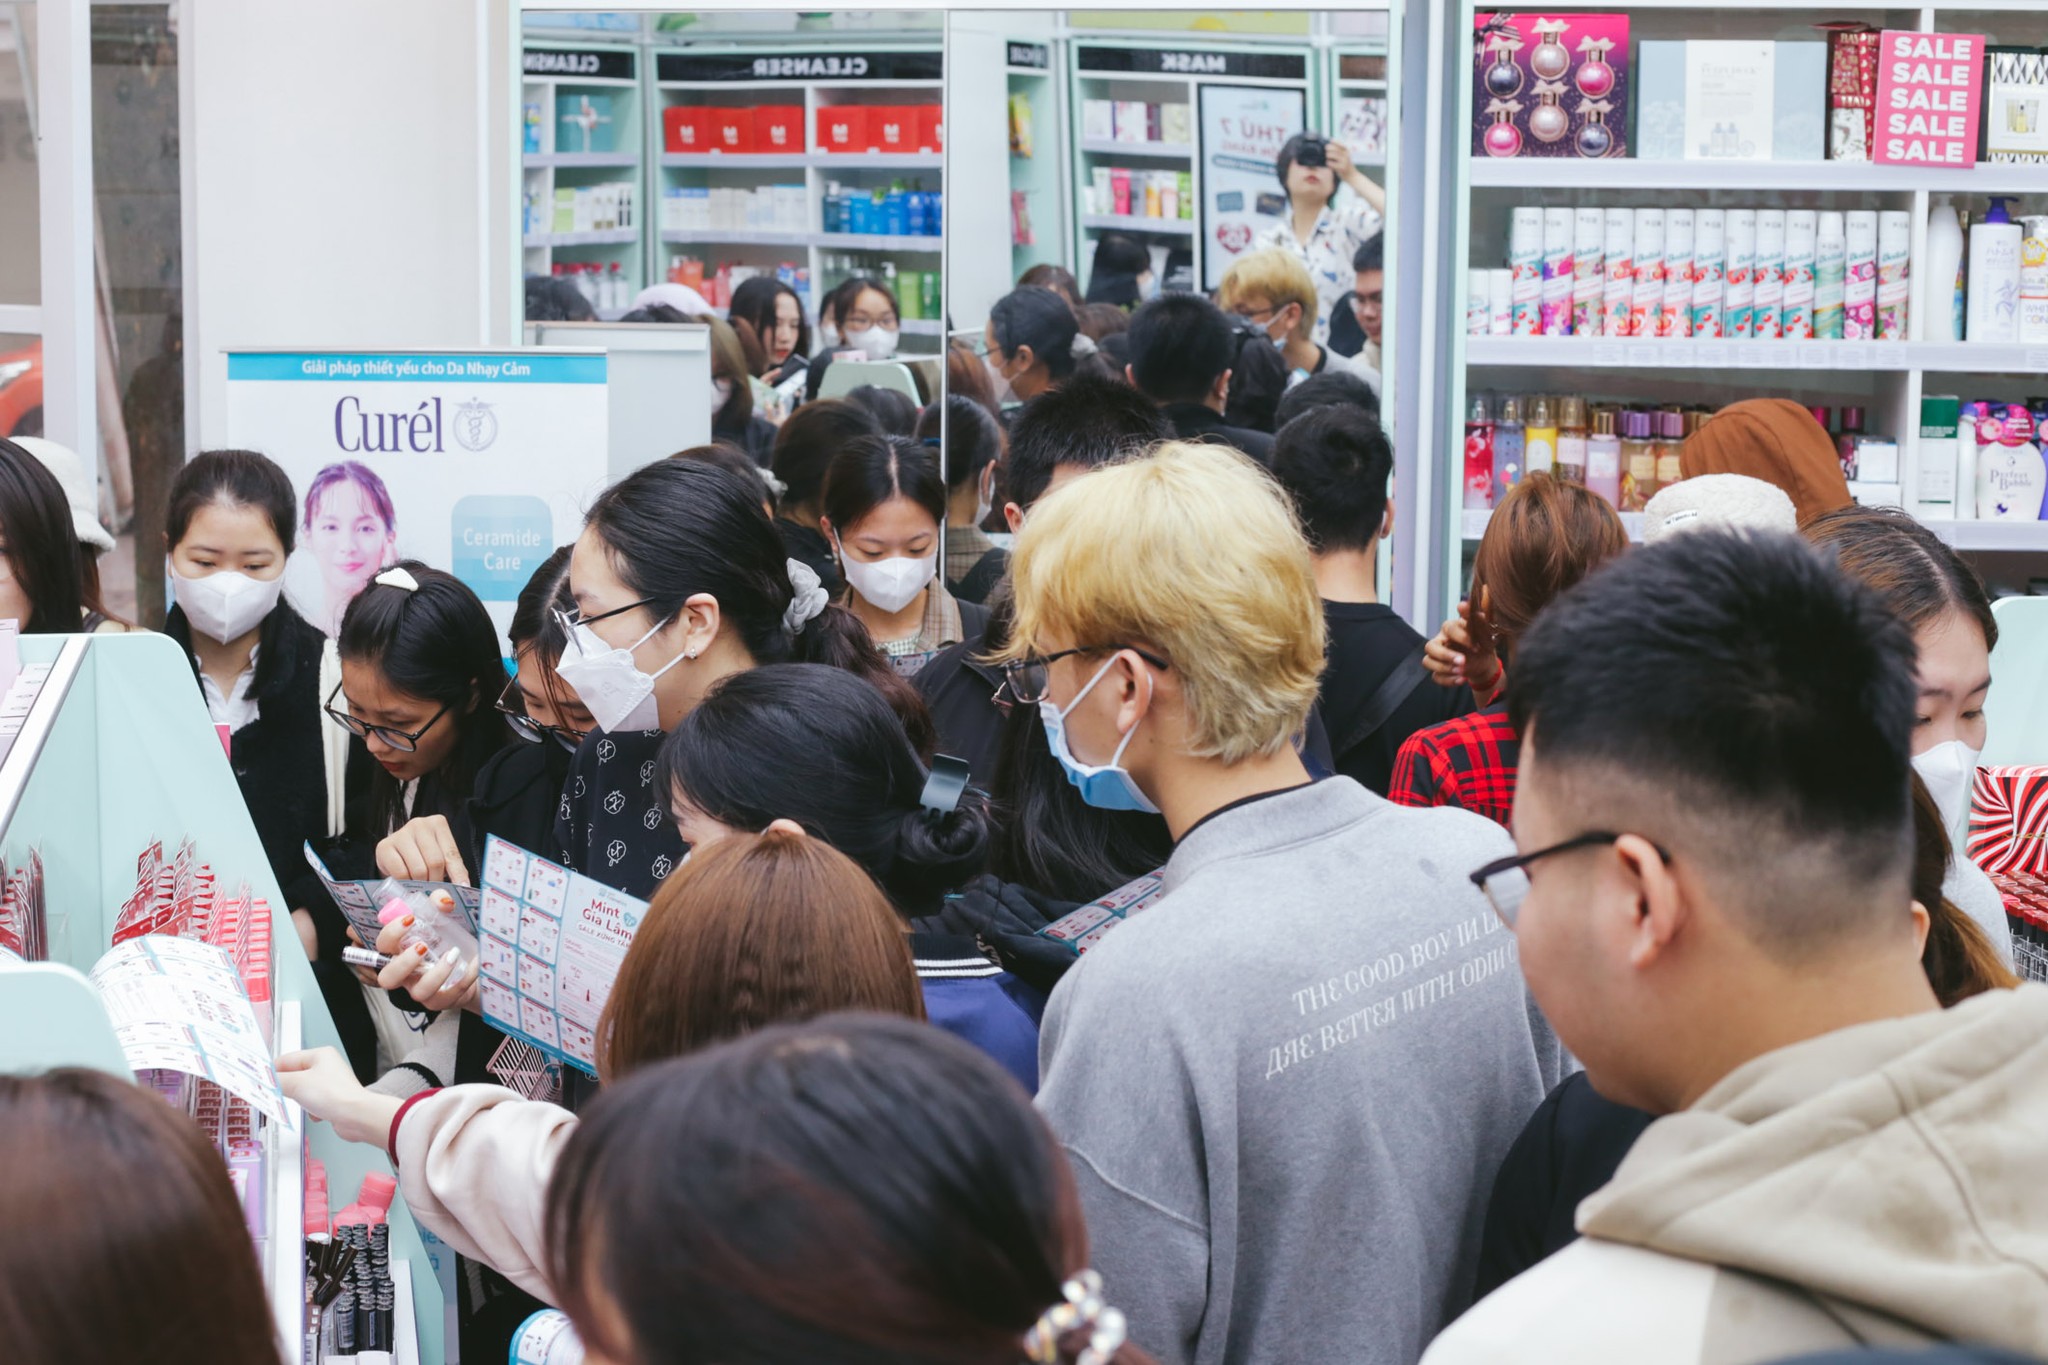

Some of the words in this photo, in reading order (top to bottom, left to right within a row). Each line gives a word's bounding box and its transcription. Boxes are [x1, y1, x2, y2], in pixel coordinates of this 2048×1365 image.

[1893, 36, 1972, 60] SALE
[1892, 62, 1970, 86] SALE
[1890, 88, 1968, 112] SALE
[1888, 113, 1966, 137] SALE
[1886, 138, 1965, 163] SALE
[302, 359, 327, 375] Giải
[329, 360, 361, 378] pháp
[363, 359, 393, 376] thiết
[396, 360, 419, 378] yếu
[421, 361, 444, 376] cho
[447, 361, 465, 376] Da
[467, 361, 499, 378] Nhạy
[501, 360, 530, 376] Cảm
[334, 395, 445, 454] Curél
[463, 527, 541, 548] Ceramide
[483, 551, 521, 570] Care
[591, 898, 620, 918] Mint
[578, 925, 594, 935] SALE
[582, 908, 603, 926] Gia
[606, 919, 633, 941] Lâm
[1345, 951, 1405, 996] GOOD
[1401, 970, 1456, 1014] WITH
